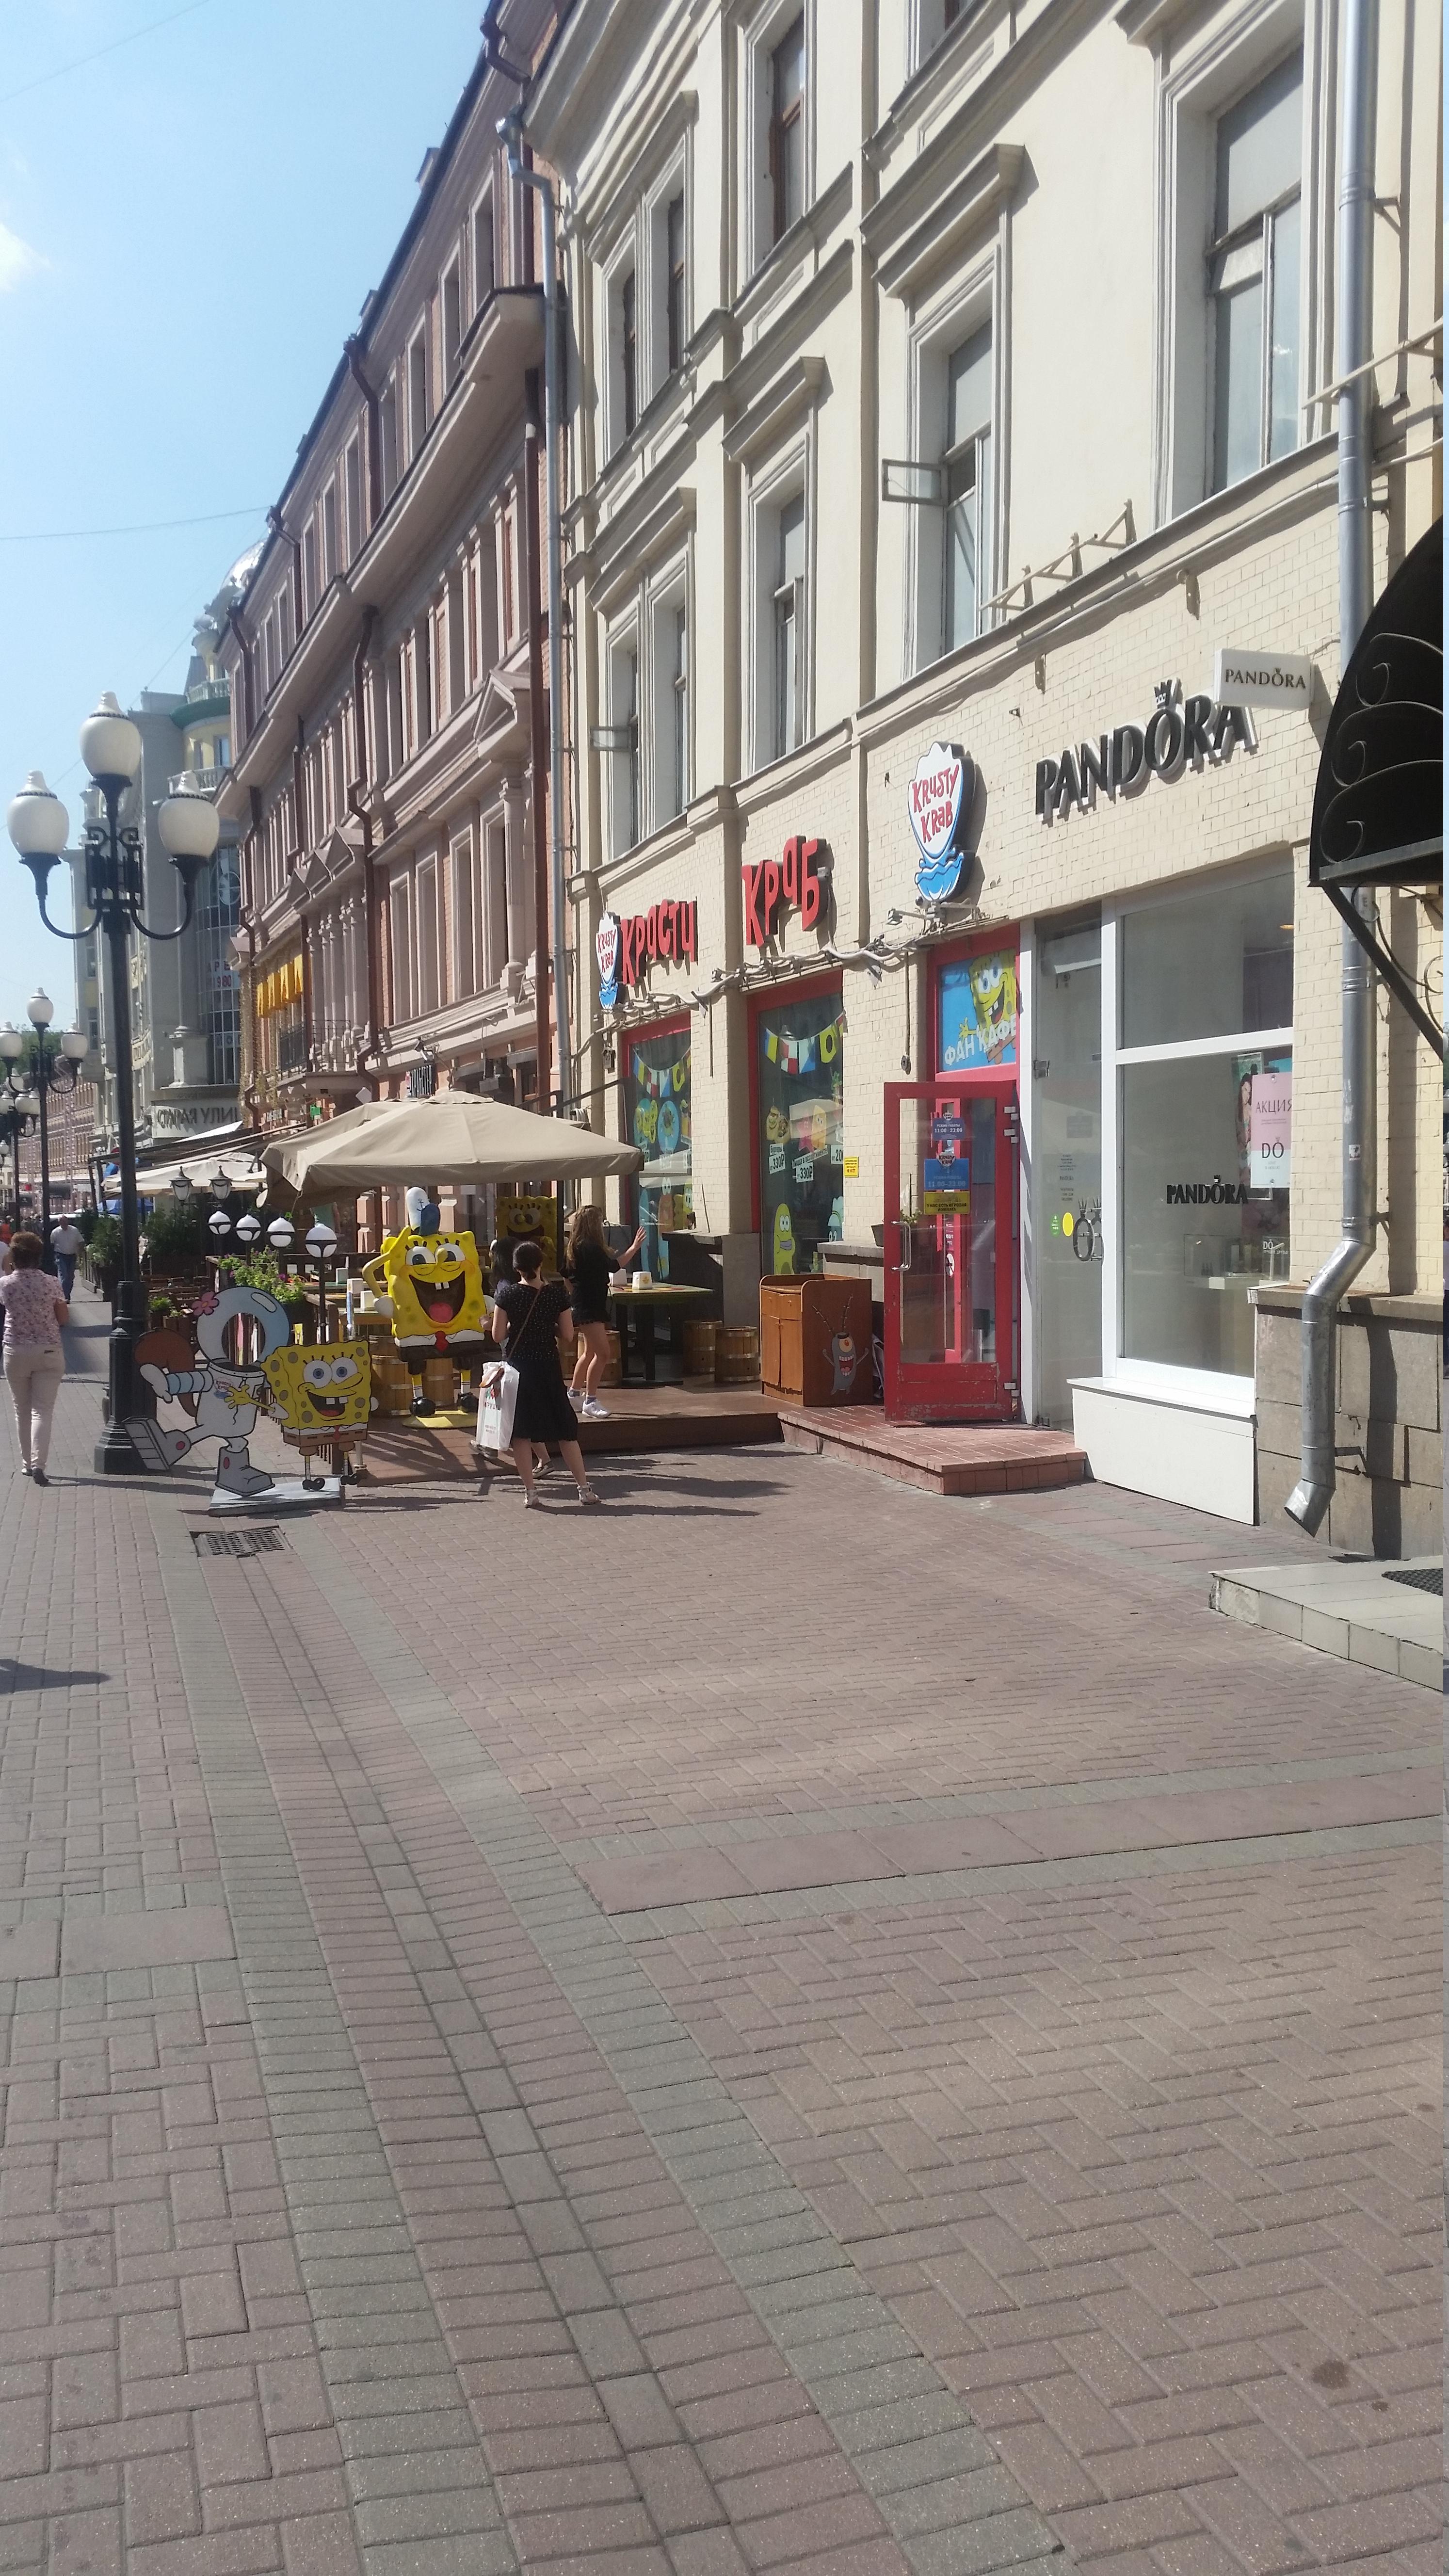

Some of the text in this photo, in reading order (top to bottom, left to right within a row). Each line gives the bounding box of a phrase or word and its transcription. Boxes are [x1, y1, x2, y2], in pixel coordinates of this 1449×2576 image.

[1225, 667, 1306, 689] PANDORA
[1035, 679, 1251, 817] PANDORA
[945, 1013, 1016, 1066] ФАН КАФЕ
[158, 1108, 197, 1126] СТАРАЯ
[1256, 1099, 1292, 1115] АКЦИЯ
[1167, 1176, 1248, 1204] PANDORA
